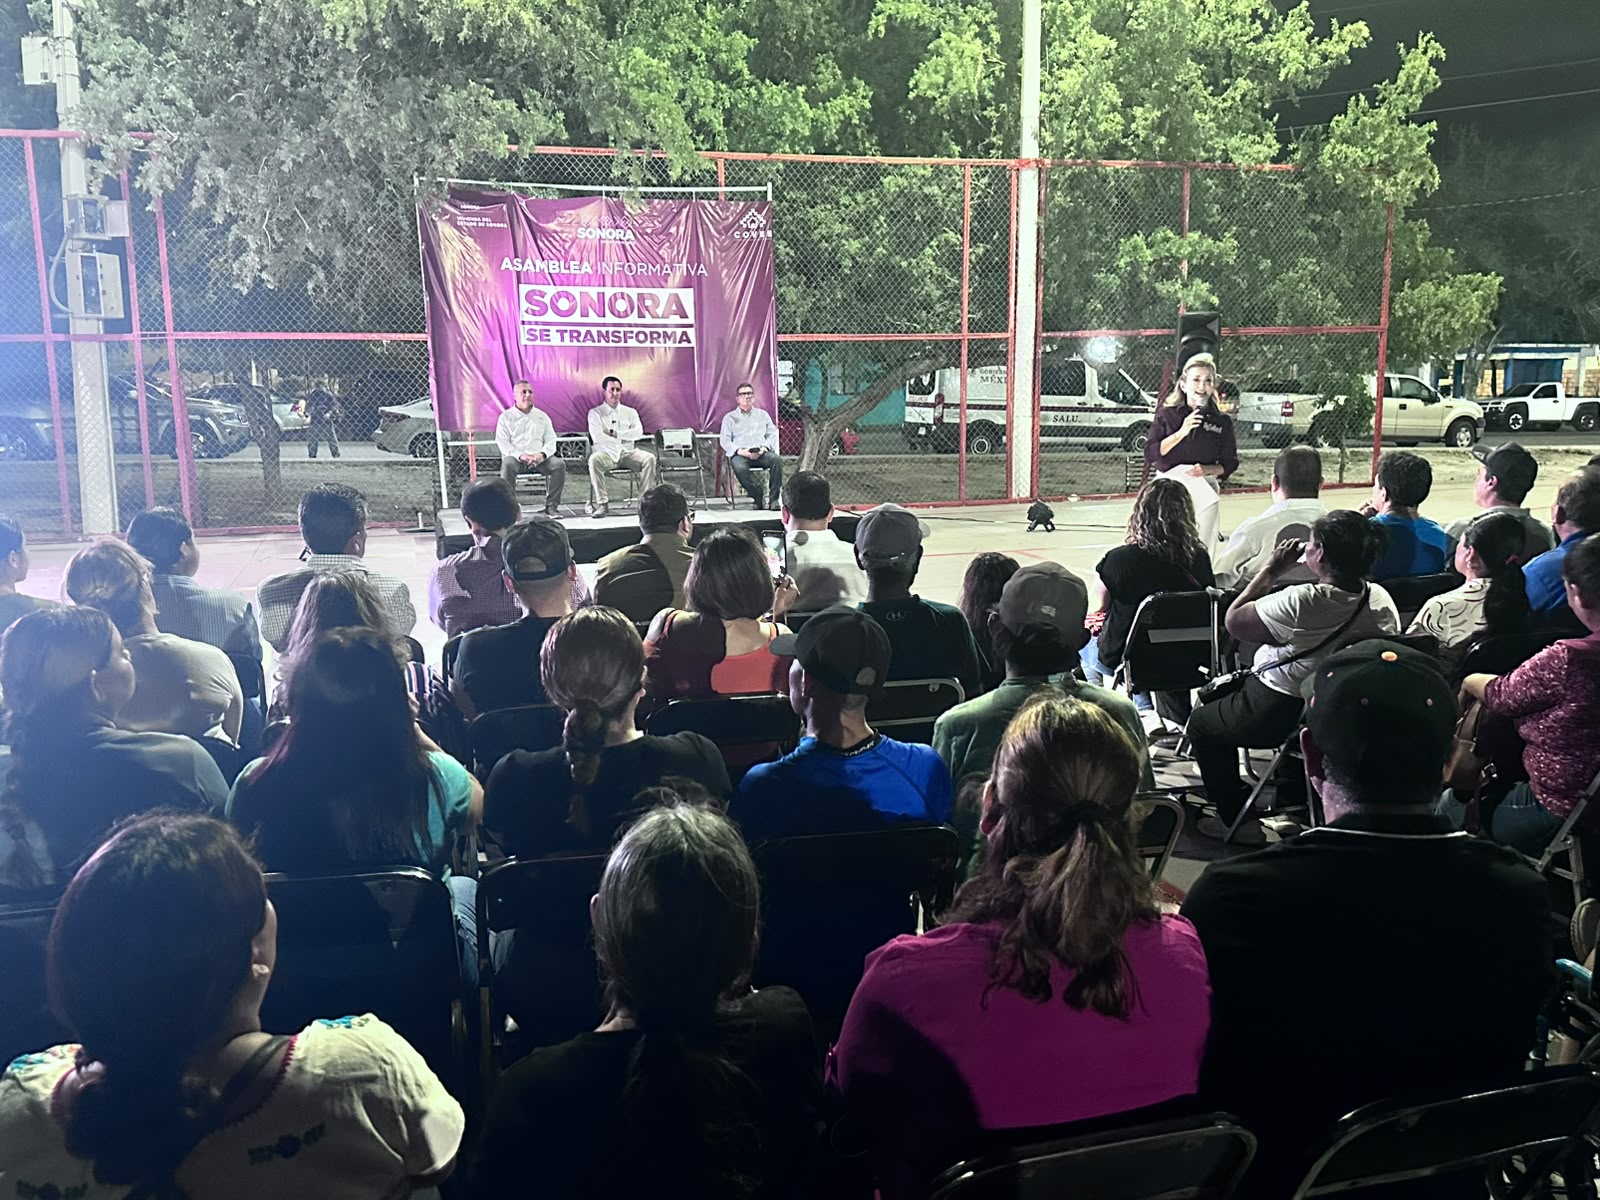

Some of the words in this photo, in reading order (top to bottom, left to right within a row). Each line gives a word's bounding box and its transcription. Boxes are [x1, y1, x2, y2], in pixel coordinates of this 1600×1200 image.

[577, 227, 635, 241] SONORA
[733, 229, 773, 240] COVES
[500, 256, 593, 275] ASAMBLEA
[597, 261, 708, 277] INFORMATIVA
[524, 289, 689, 319] SONORA
[526, 328, 551, 343] SE
[556, 329, 692, 345] TRANSFORMA
[980, 374, 1007, 384] MÉXI
